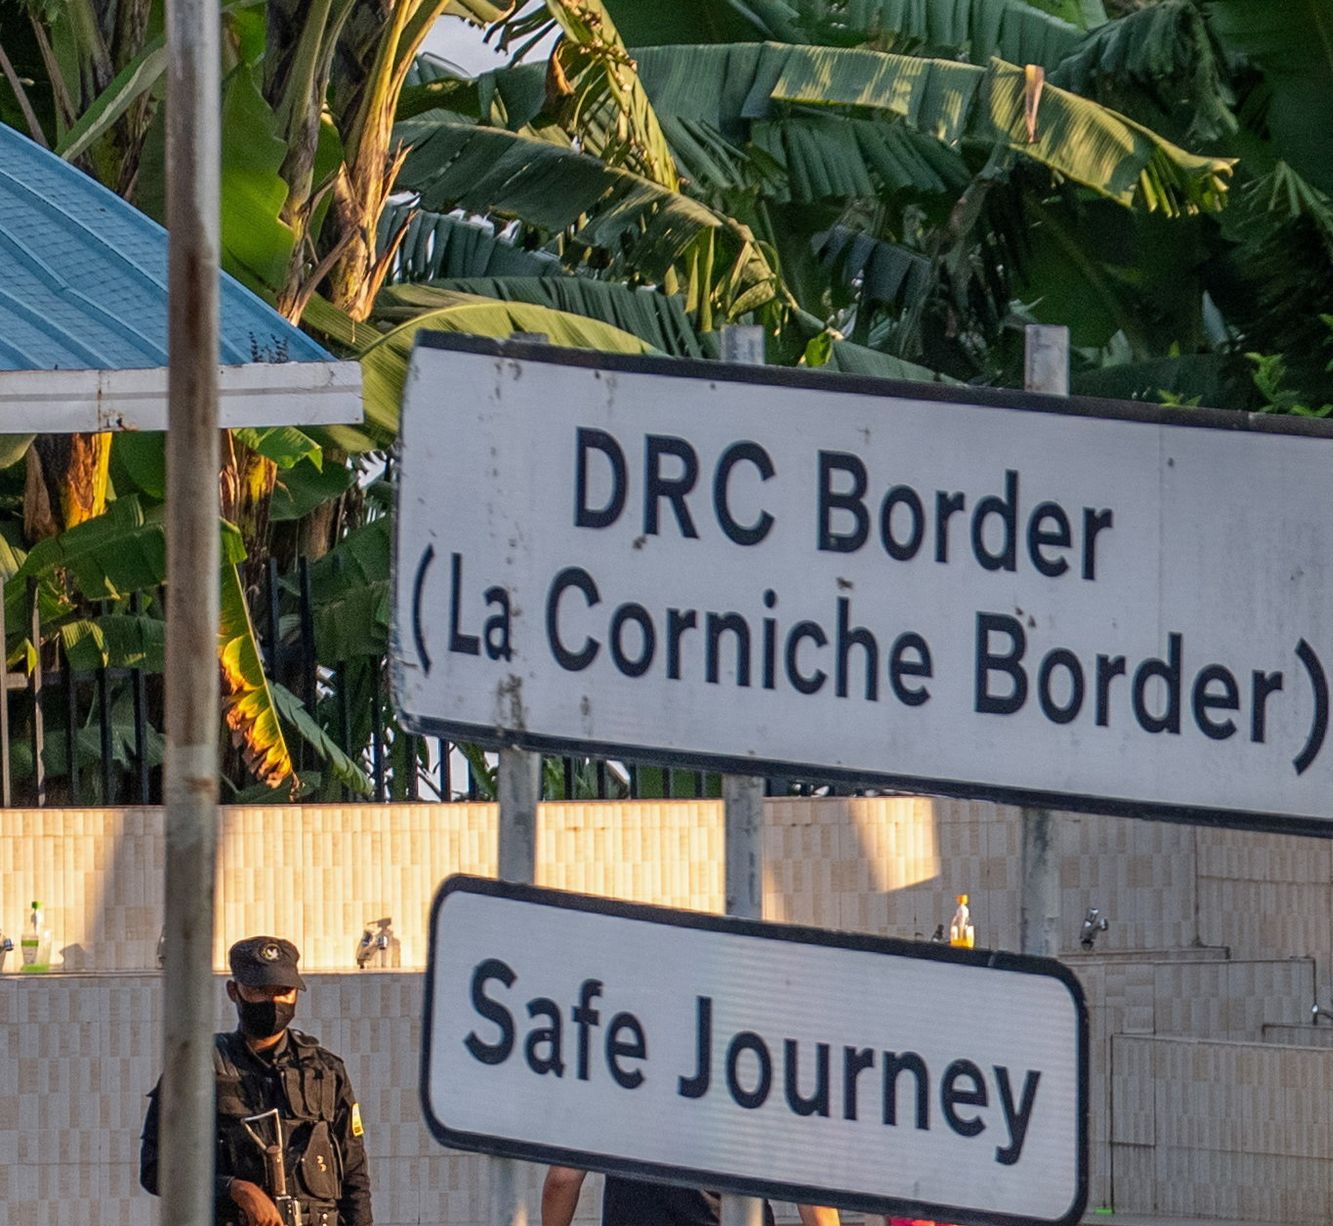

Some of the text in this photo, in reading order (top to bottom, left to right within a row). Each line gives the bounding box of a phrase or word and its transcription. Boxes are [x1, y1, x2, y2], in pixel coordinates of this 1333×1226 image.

[574, 426, 1112, 581] DRC Border
[411, 543, 1330, 776] (La Corniche Border)
[463, 957, 1041, 1166] Safe Journey
